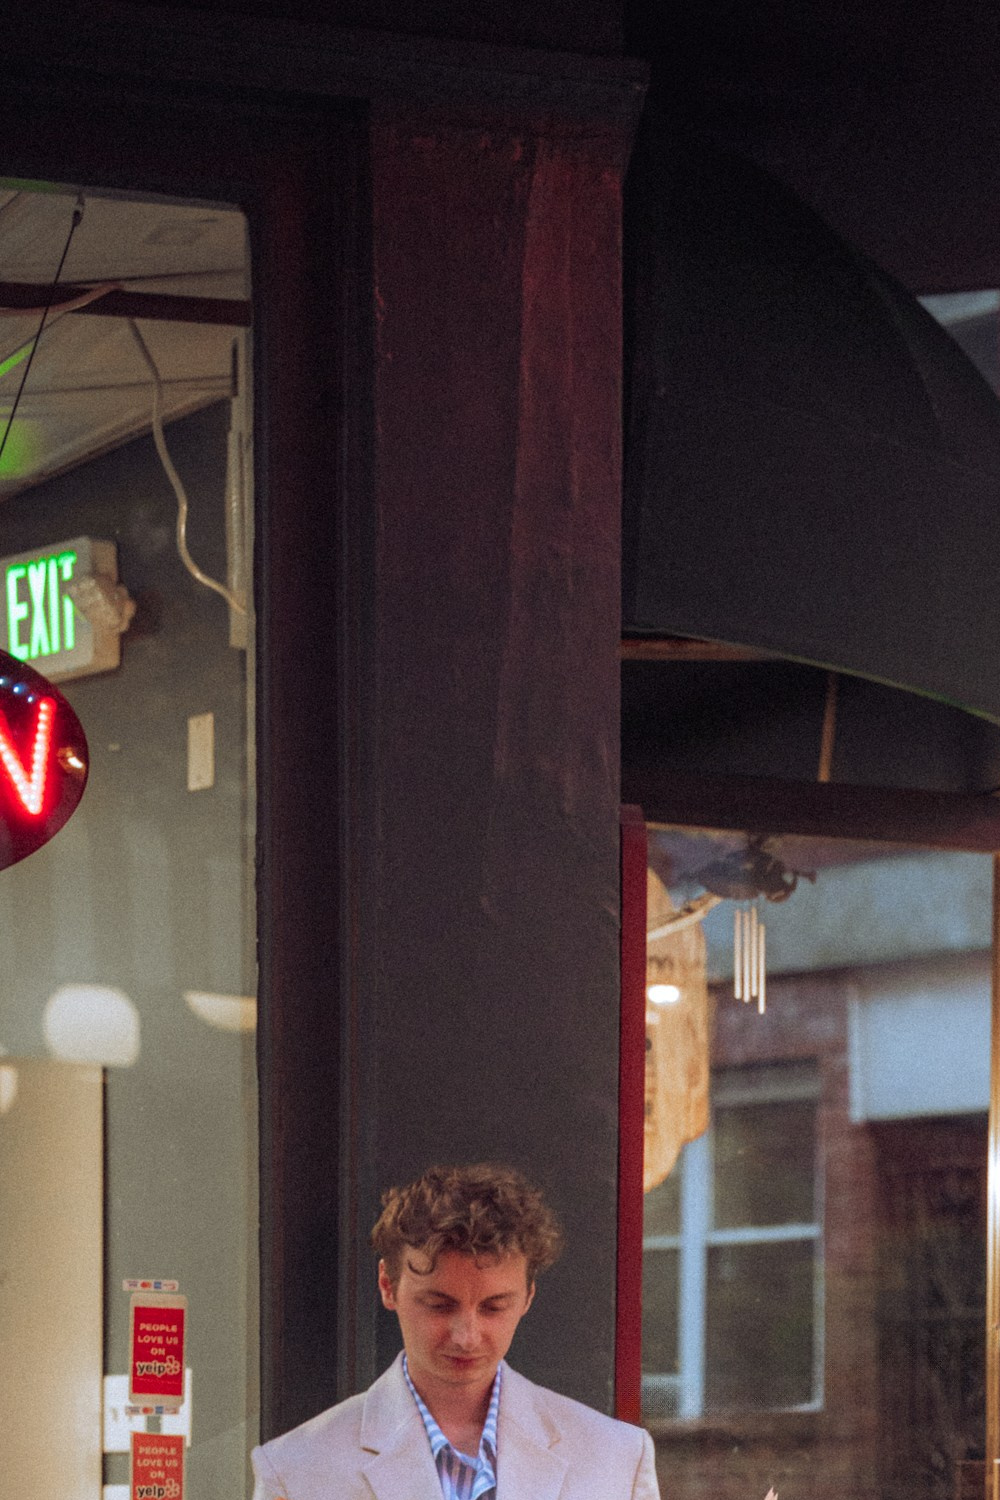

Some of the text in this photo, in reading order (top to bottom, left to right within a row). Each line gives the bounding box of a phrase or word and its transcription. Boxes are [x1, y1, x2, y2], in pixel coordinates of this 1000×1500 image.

[6, 552, 77, 661] EXIT
[139, 1323, 178, 1333] PEOPLE
[137, 1335, 179, 1345] LOVE US
[150, 1347, 165, 1355] ON
[136, 1361, 166, 1377] yelp
[139, 1446, 177, 1456] PEOPLE
[137, 1459, 178, 1468] LOVE US
[149, 1471, 165, 1479] ON
[136, 1484, 166, 1498] yelp
